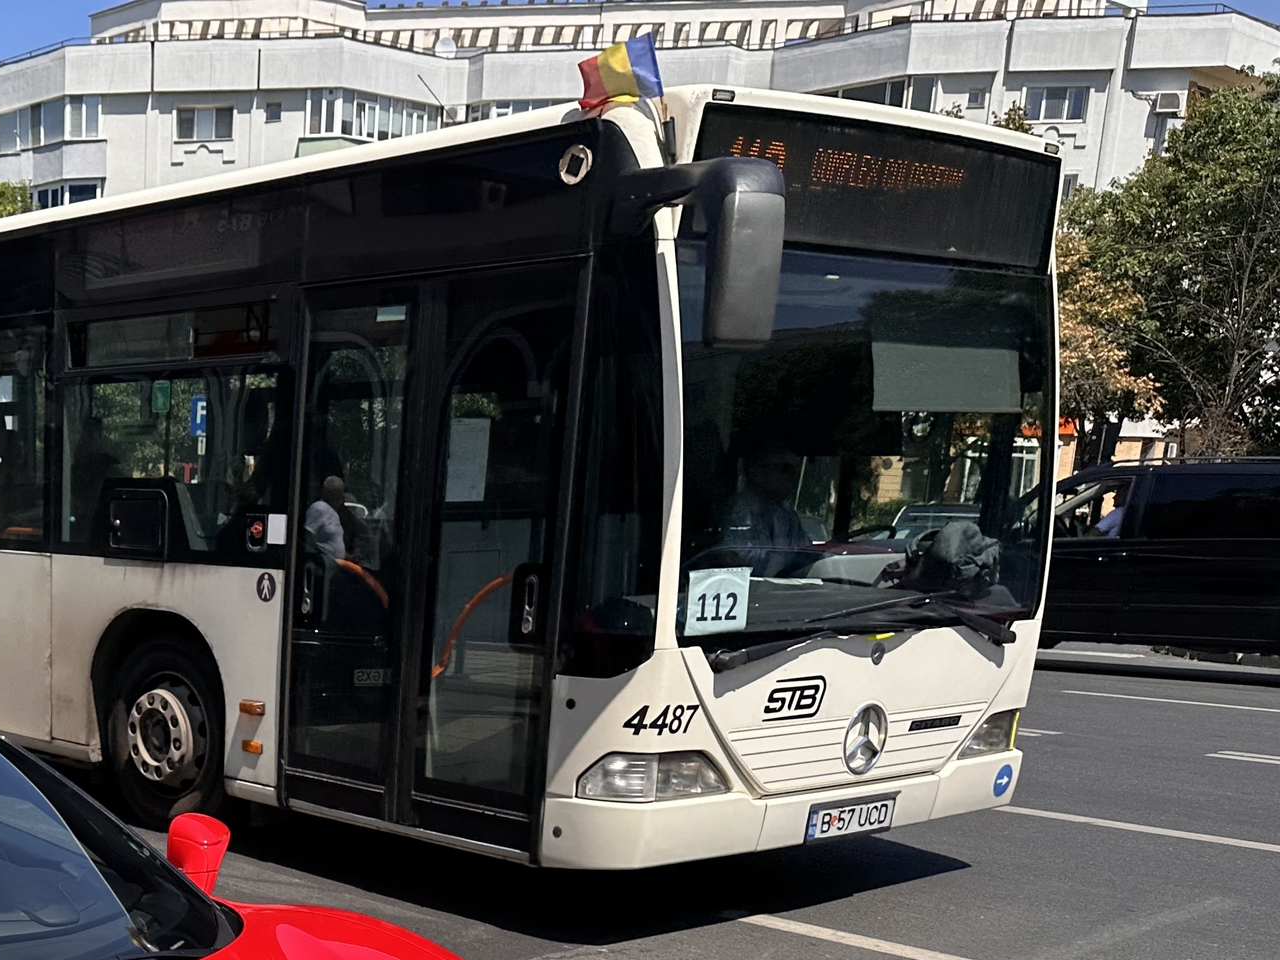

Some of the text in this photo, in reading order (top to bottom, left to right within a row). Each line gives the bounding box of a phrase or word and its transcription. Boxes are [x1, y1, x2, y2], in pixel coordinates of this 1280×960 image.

[696, 592, 738, 621] 112
[763, 684, 820, 714] STB
[622, 704, 700, 736] 4487
[911, 716, 960, 730] CITARO
[820, 803, 888, 834] B 57 UCD
